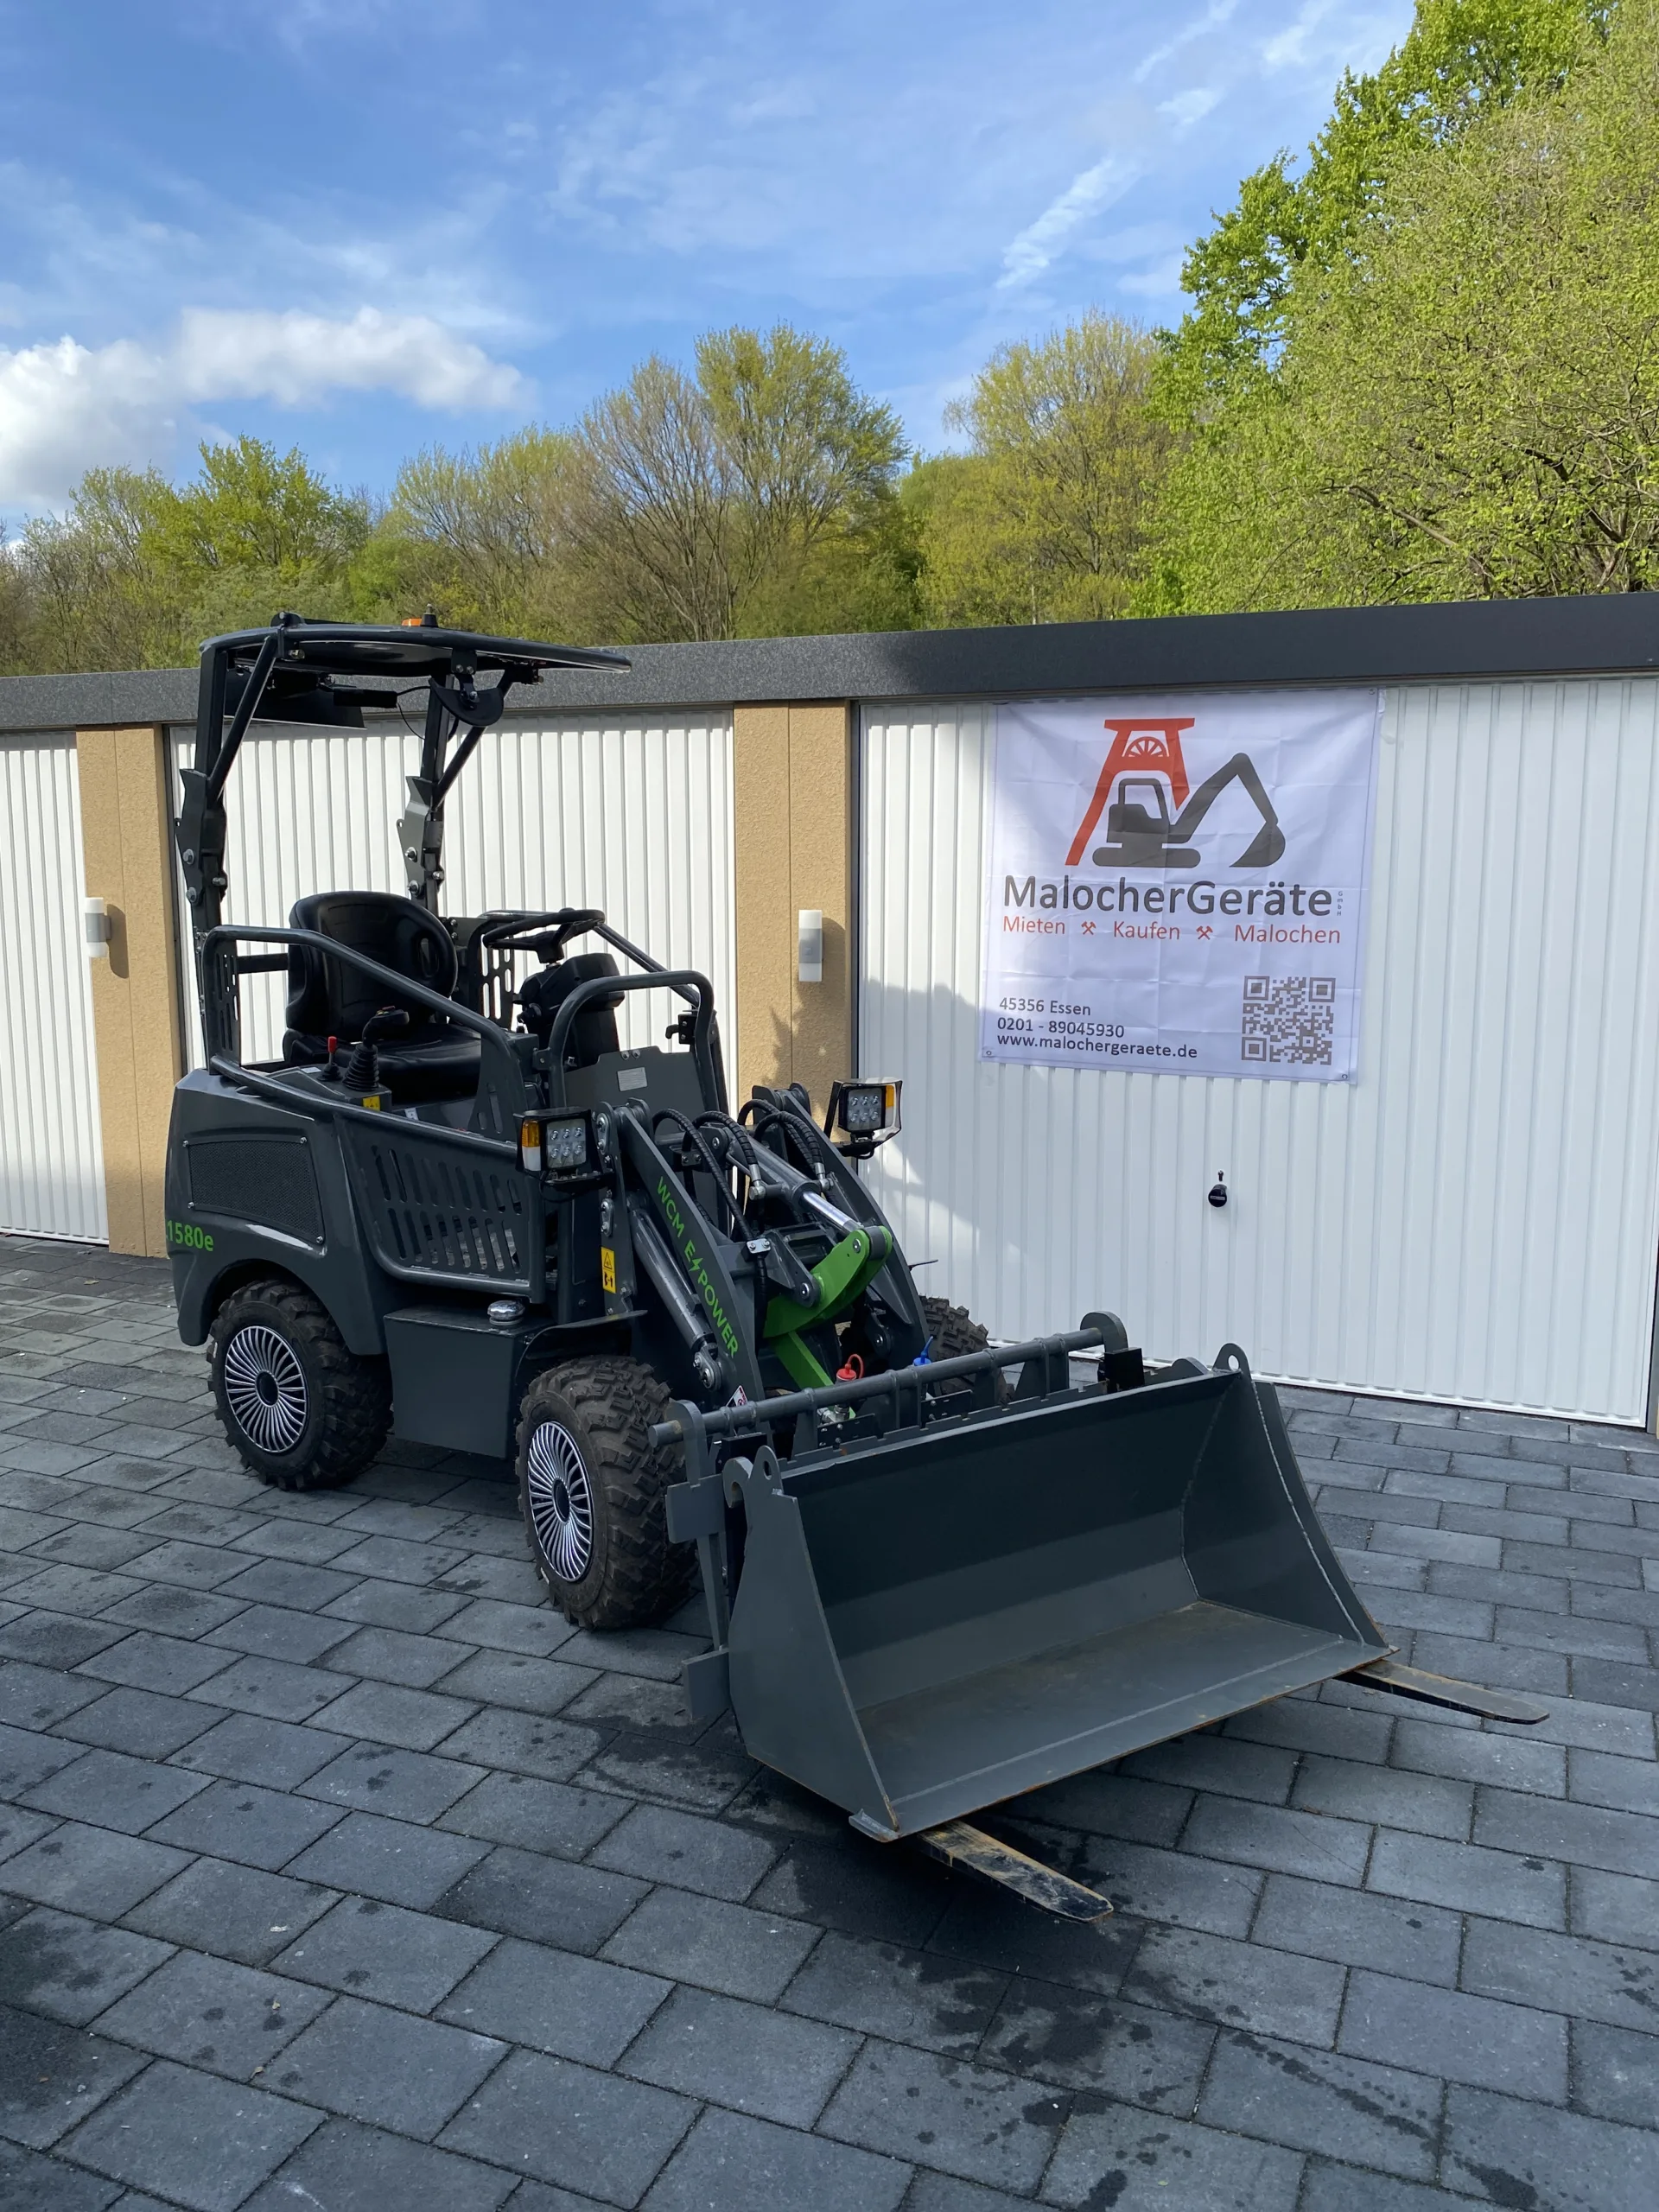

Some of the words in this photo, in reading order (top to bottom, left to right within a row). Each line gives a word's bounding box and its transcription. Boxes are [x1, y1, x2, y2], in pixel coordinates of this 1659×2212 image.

[1003, 874, 1332, 917] MalocherGeräte
[1002, 916, 1066, 935] Mieten
[1113, 920, 1181, 940] Kaufen
[1234, 924, 1341, 944] Malochen
[999, 997, 1045, 1014] 45356
[1050, 1000, 1091, 1016] Essen
[997, 1017, 1033, 1033] 0201
[1048, 1020, 1125, 1039] 89045930
[996, 1033, 1198, 1059] www.malochergeraete.de
[656, 1175, 685, 1238] WCM
[165, 1219, 214, 1252] 1580e
